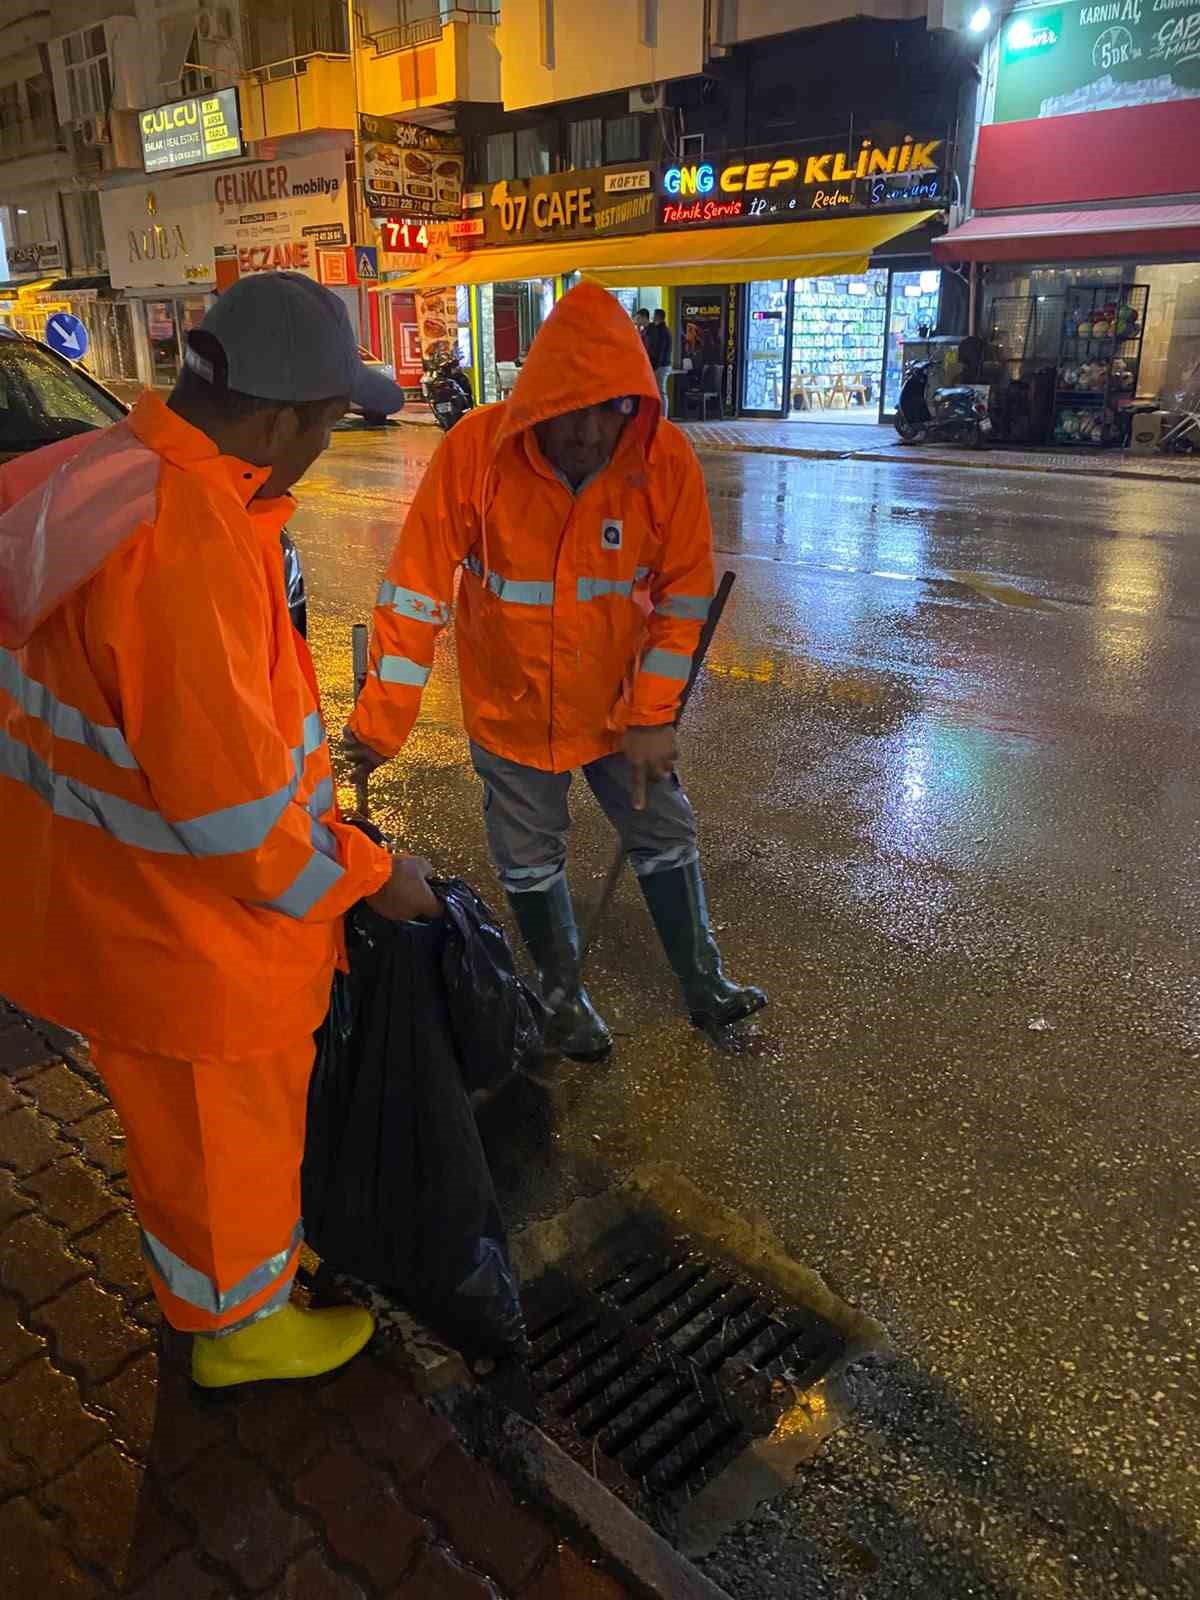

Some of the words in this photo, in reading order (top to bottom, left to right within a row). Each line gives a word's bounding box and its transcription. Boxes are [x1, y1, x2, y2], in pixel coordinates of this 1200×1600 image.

[1080, 4, 1120, 25] KARNIN
[664, 165, 714, 194] GNG
[720, 159, 799, 192] CEP
[804, 135, 942, 184] KLİNİK
[214, 166, 290, 215] ÇELİKLER
[292, 177, 339, 197] mobilya
[500, 196, 527, 231] 07
[533, 187, 592, 228] CAFE
[664, 203, 701, 223] Teknik
[704, 200, 741, 219] Servis
[239, 241, 309, 273] ECZANE
